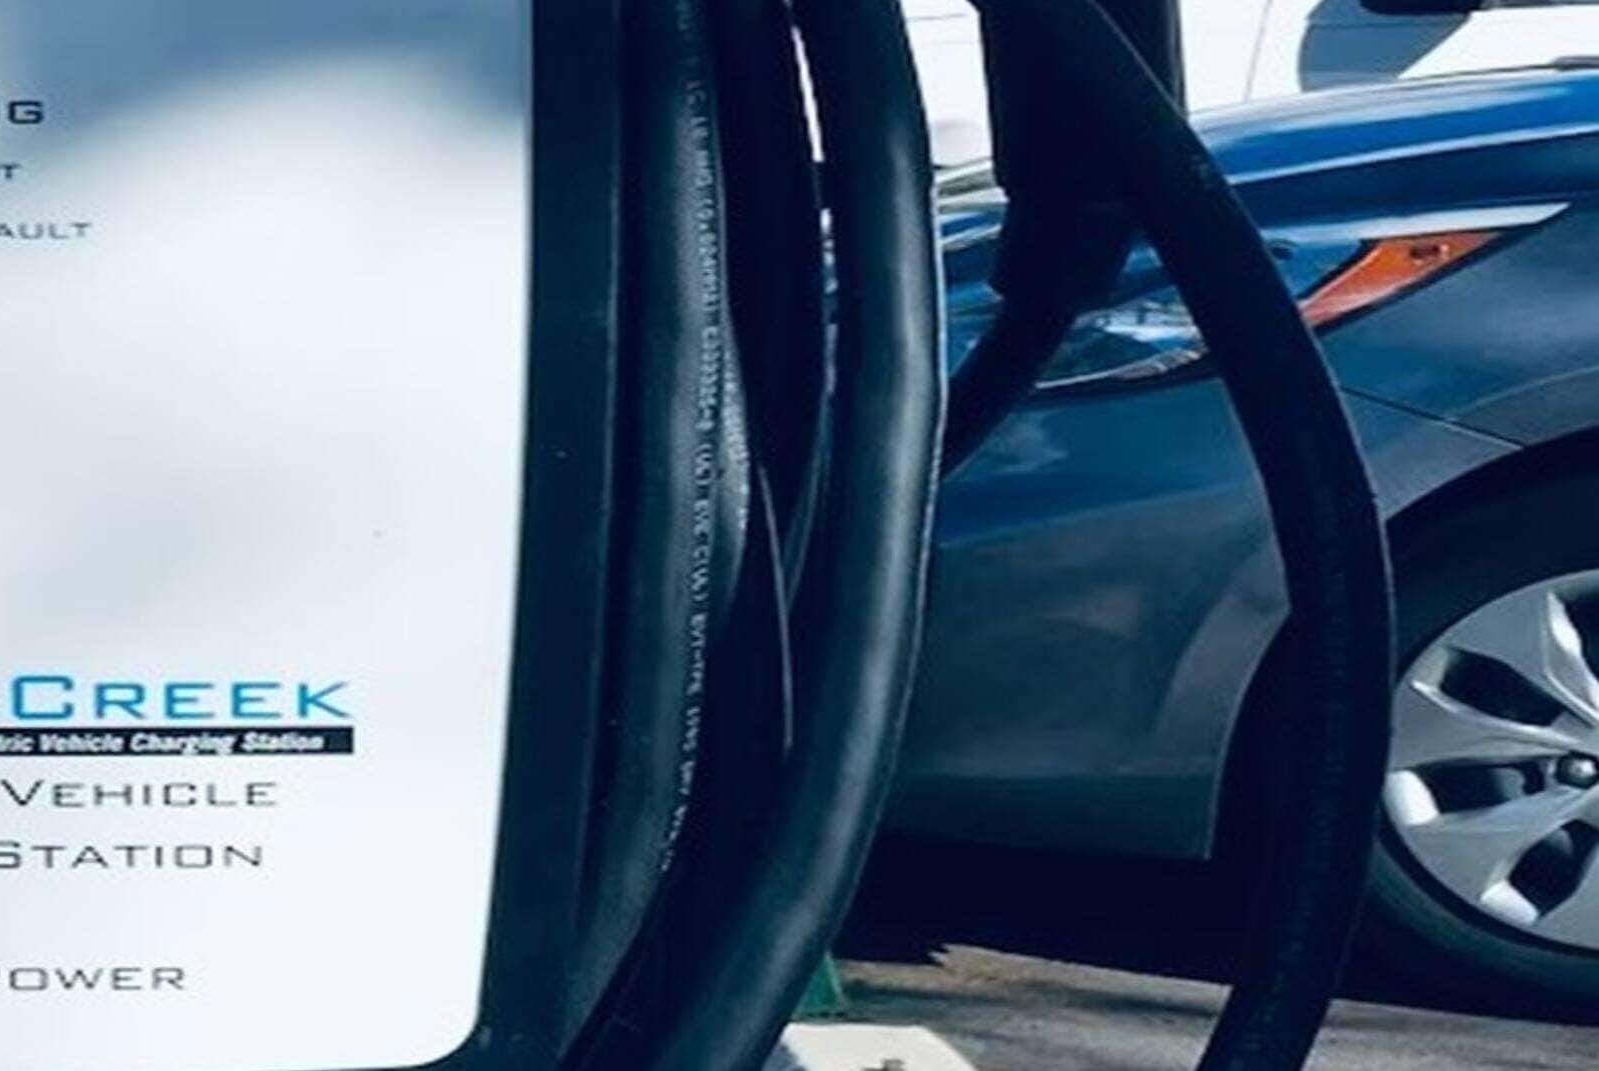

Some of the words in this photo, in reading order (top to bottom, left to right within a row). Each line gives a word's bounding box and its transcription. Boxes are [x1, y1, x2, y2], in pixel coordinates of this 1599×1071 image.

[38, 735, 124, 753] Vehicle
[129, 733, 236, 756] Charging
[240, 731, 325, 751] Station
[0, 778, 278, 808] VEHICLE
